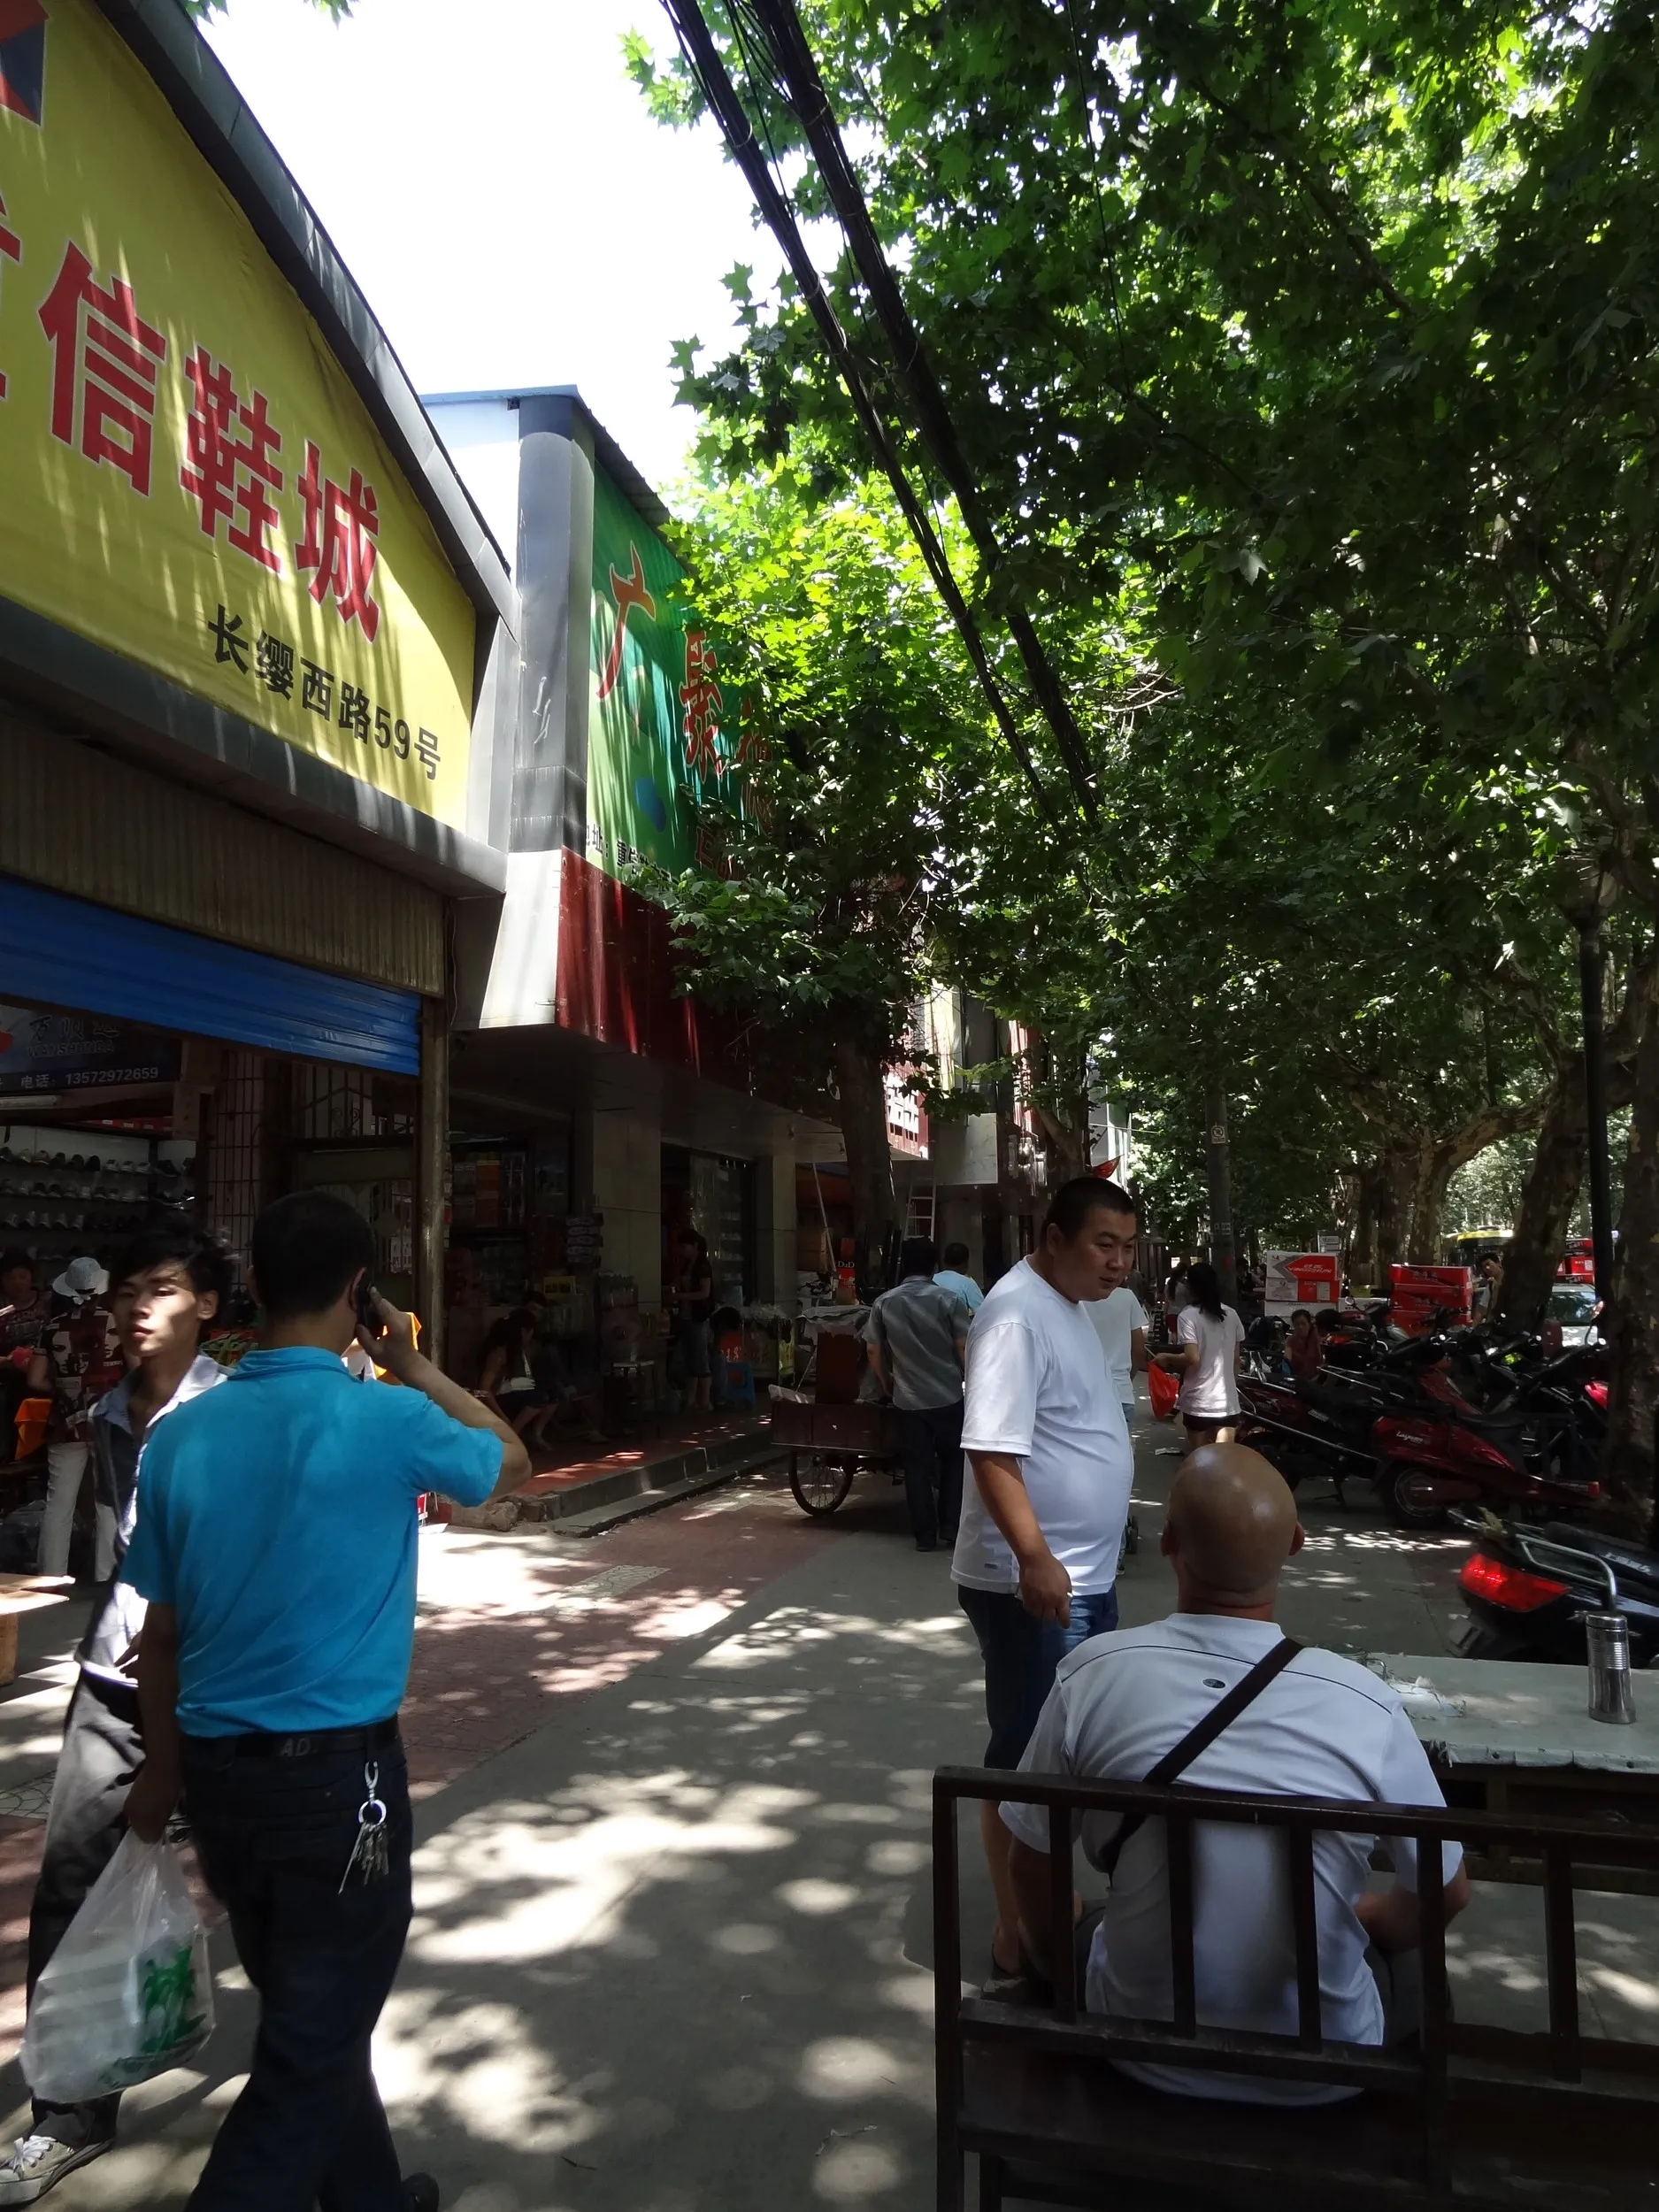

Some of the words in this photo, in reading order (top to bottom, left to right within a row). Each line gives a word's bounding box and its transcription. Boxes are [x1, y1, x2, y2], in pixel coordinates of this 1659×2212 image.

[0, 196, 379, 643] 信鞋城
[208, 603, 441, 780] 长缨西路59号
[65, 1066, 159, 1086] 13572972659
